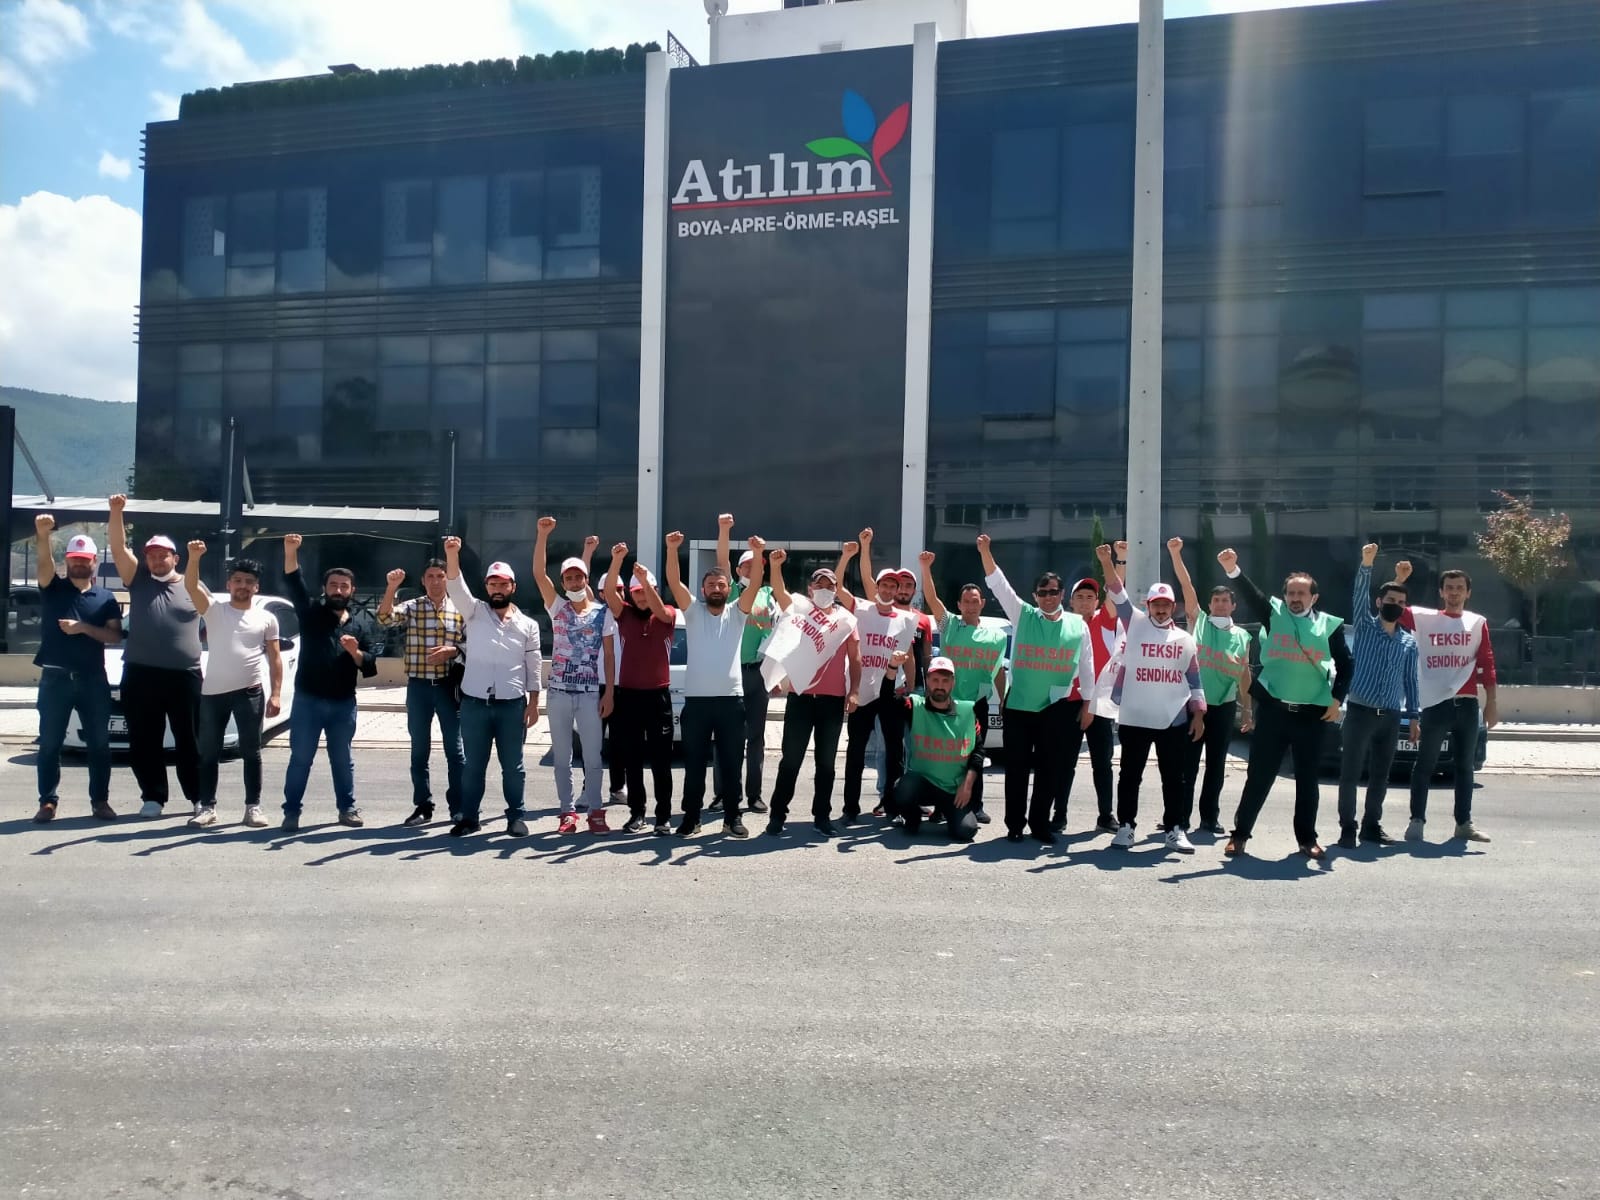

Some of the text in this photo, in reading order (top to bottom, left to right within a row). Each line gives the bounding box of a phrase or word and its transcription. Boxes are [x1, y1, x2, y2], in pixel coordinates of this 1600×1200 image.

[672, 153, 876, 204] Atılım
[678, 208, 900, 237] BOYA-APRE-ÖRME-RAŞEL
[866, 633, 899, 650] TEKSİF
[1428, 631, 1472, 646] TEKSİF
[1141, 642, 1183, 659] TEKSİF
[861, 652, 888, 670] SENDİK
[1136, 664, 1183, 683] SENDİKAS
